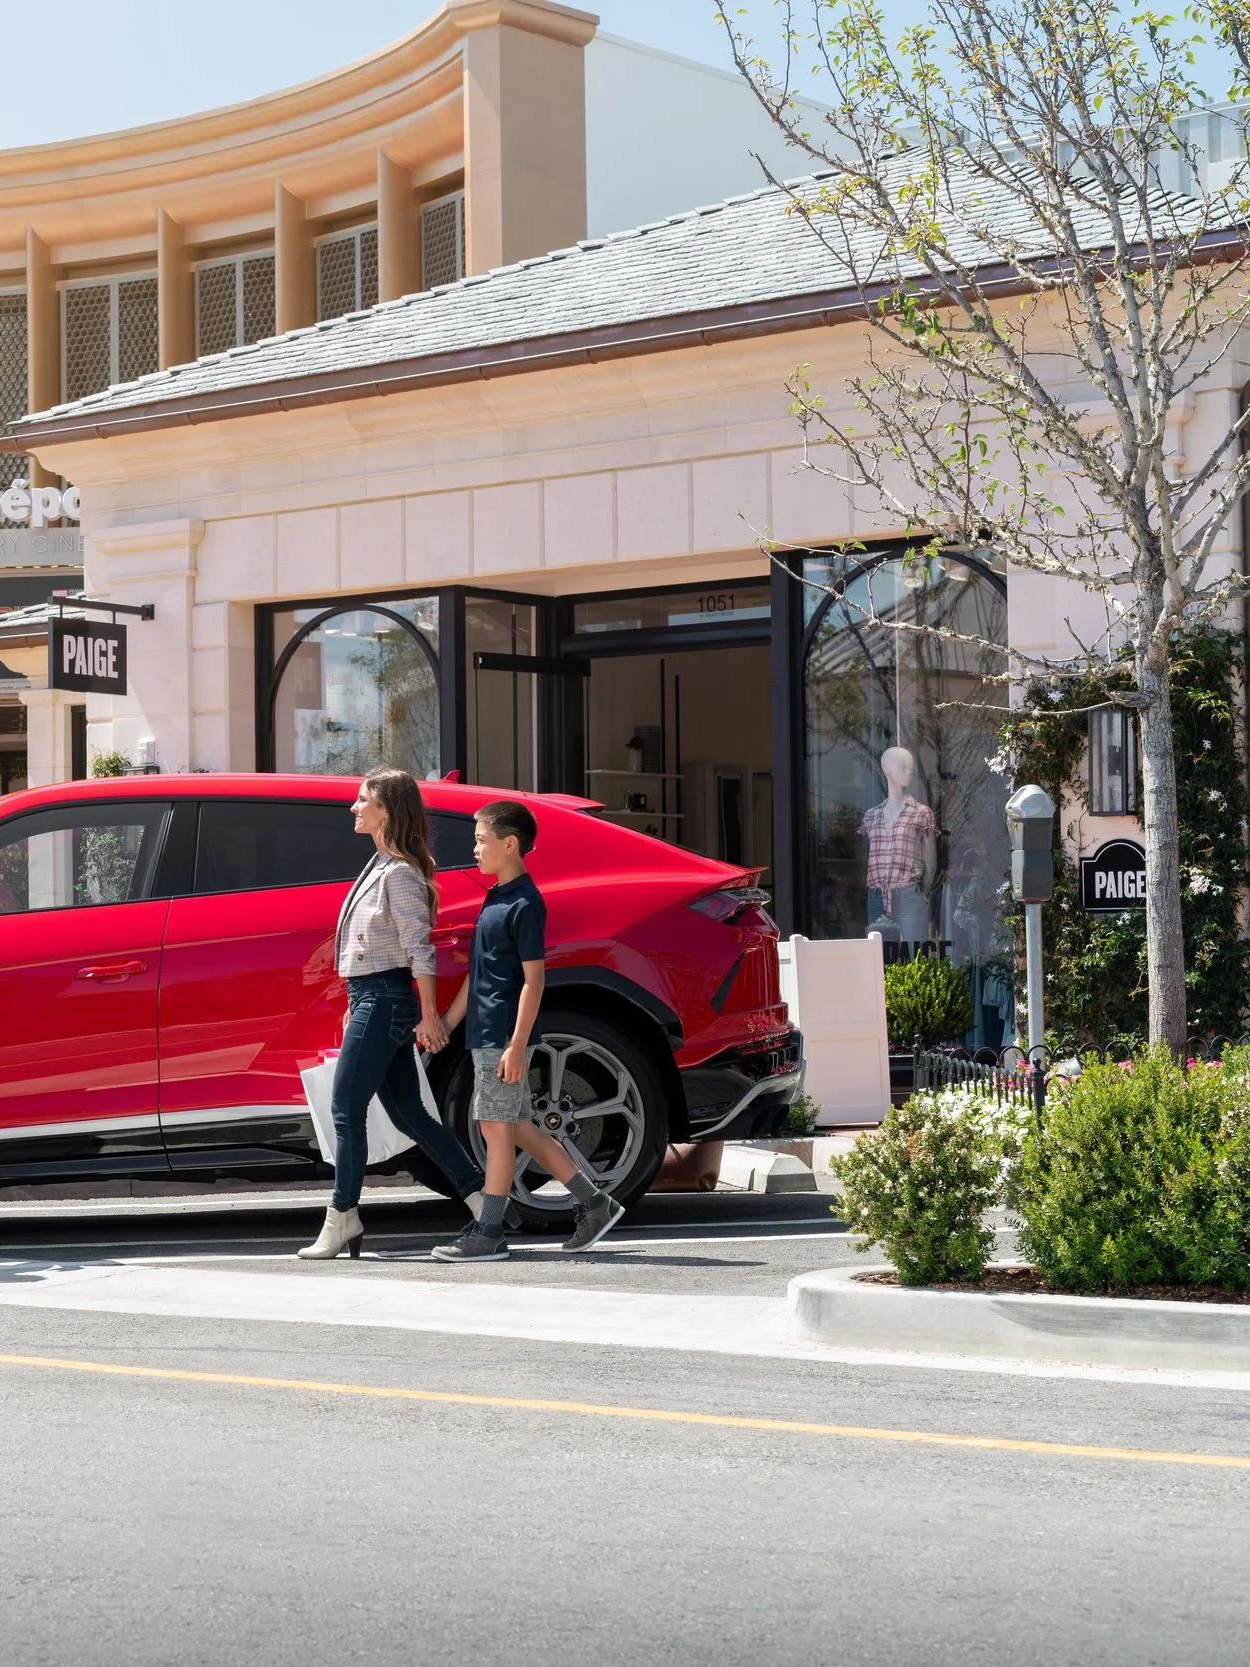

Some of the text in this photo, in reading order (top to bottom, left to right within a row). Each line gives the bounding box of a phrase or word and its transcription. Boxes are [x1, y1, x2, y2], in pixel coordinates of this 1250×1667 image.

[697, 593, 734, 612] 1051
[63, 634, 119, 679] PAIGE
[1095, 871, 1146, 899] PAIGE
